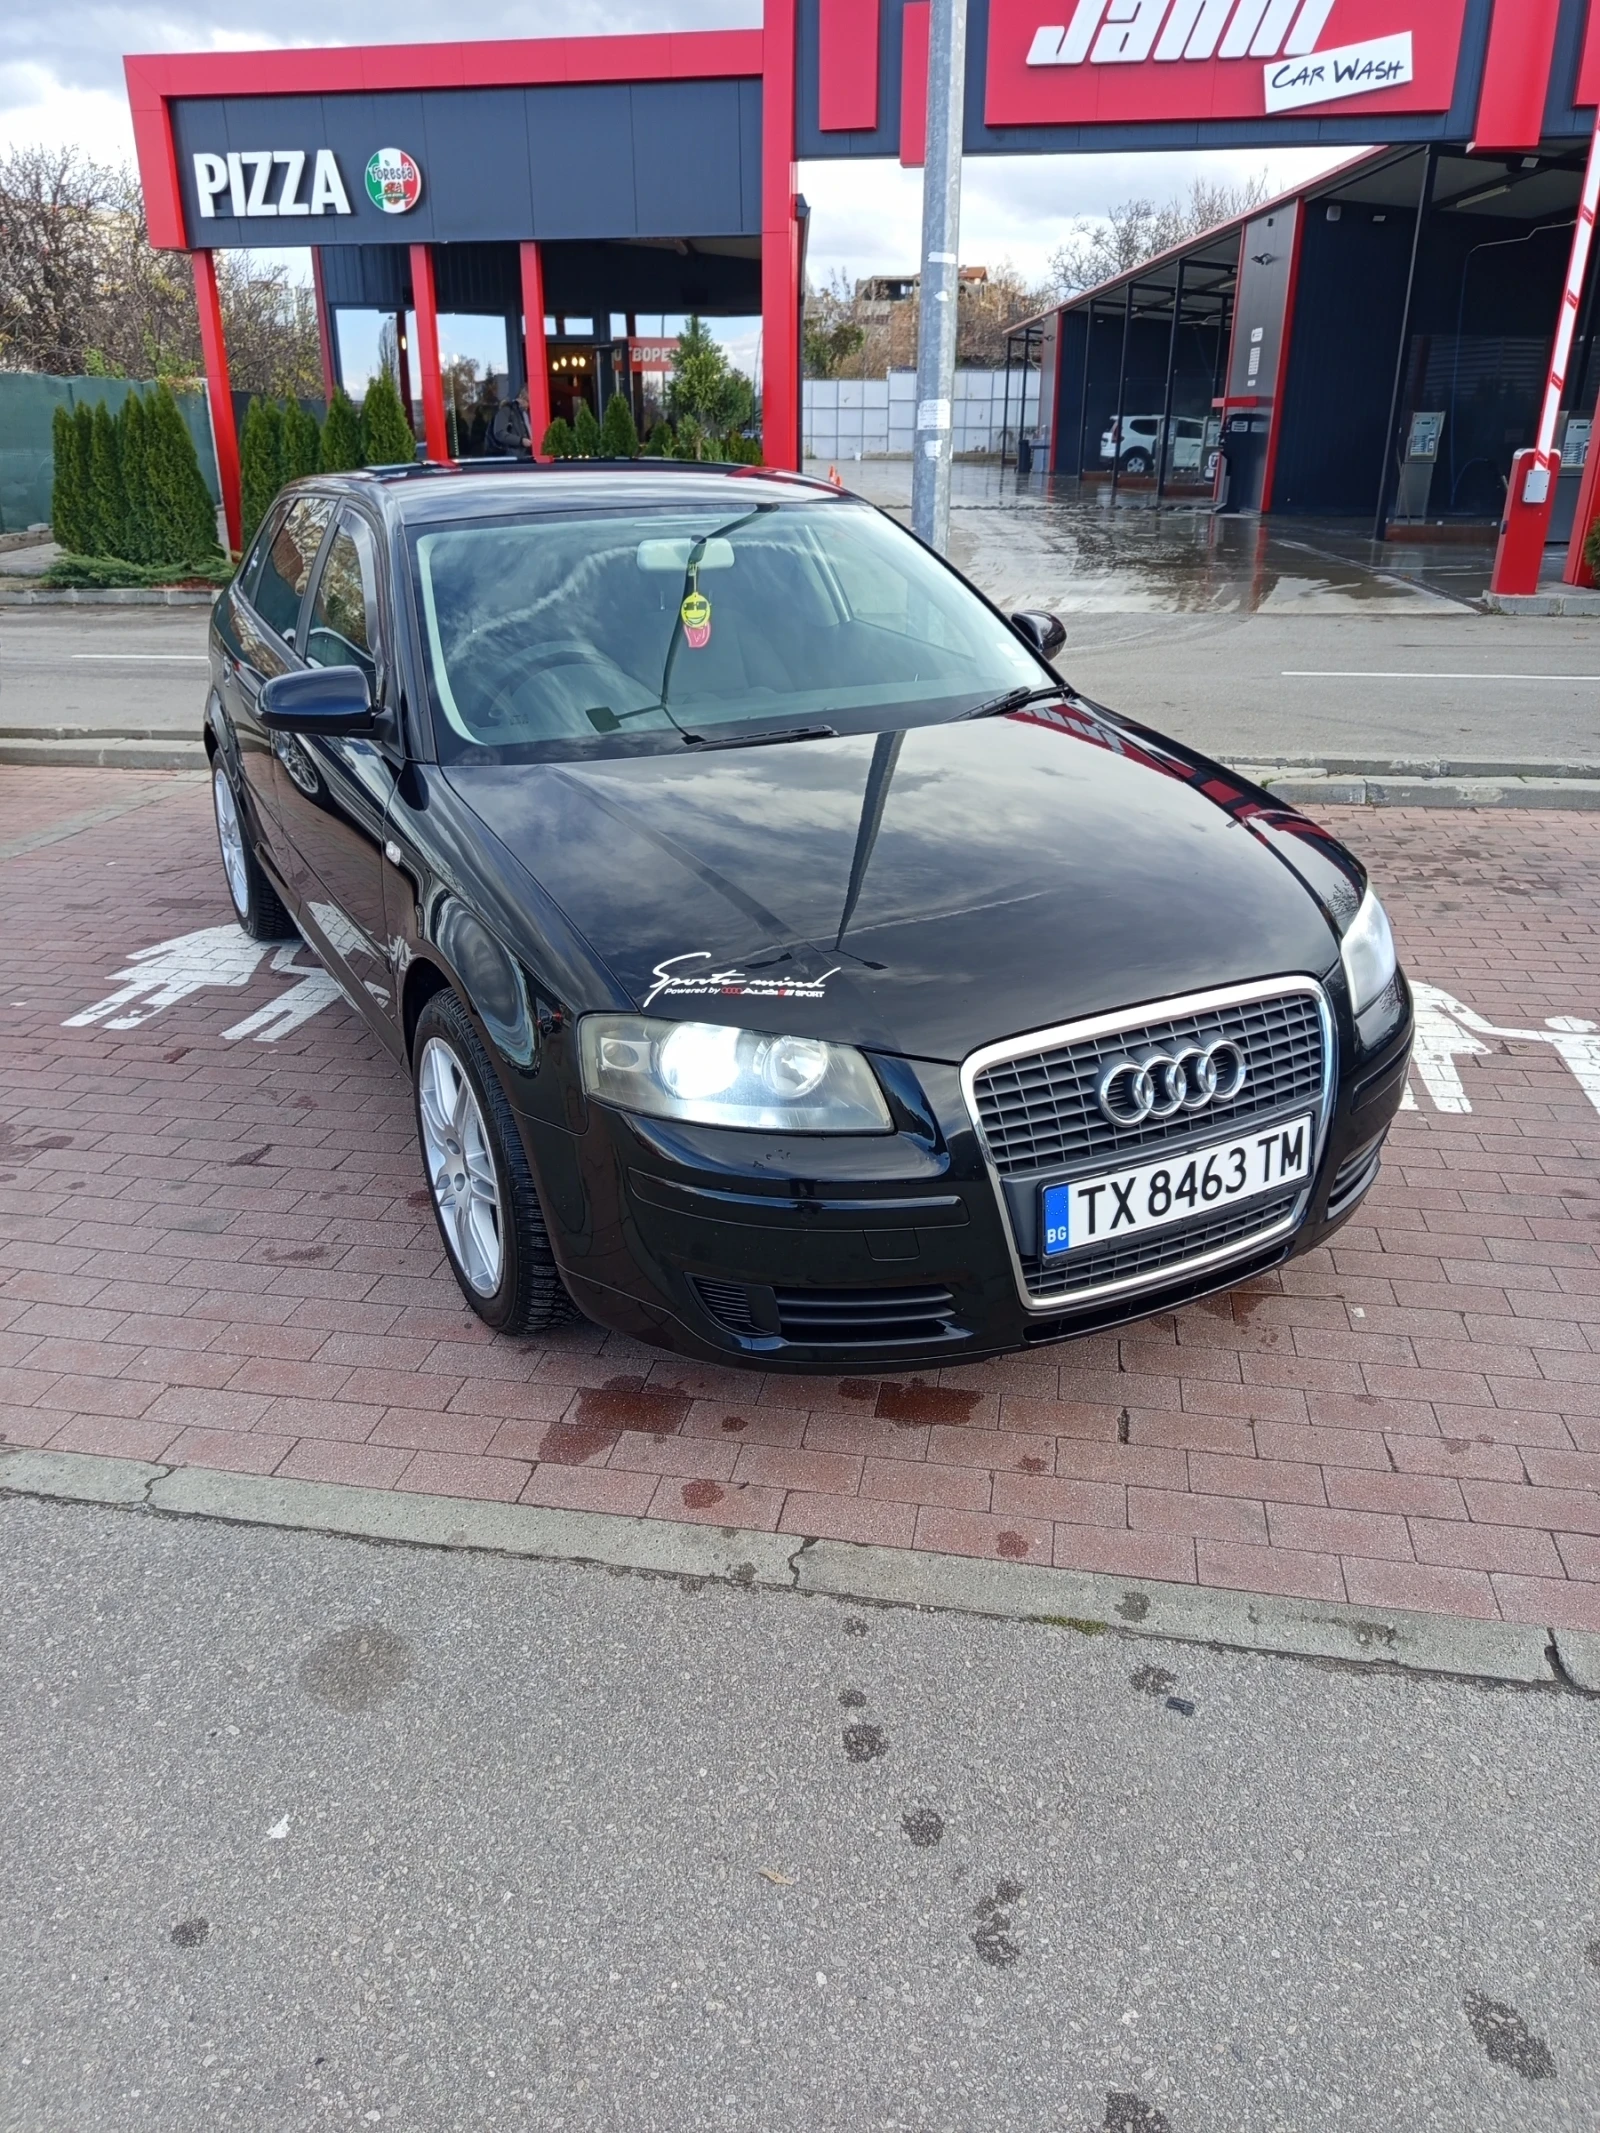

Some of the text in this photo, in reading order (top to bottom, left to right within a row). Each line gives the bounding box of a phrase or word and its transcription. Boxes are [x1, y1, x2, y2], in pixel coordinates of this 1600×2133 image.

[1272, 58, 1404, 88] CAR WASH
[193, 149, 352, 217] PIZZA
[664, 987, 707, 995] Powered
[707, 987, 721, 995] by
[1077, 1125, 1304, 1236] TX 8463 TM
[1047, 1225, 1067, 1244] BG
